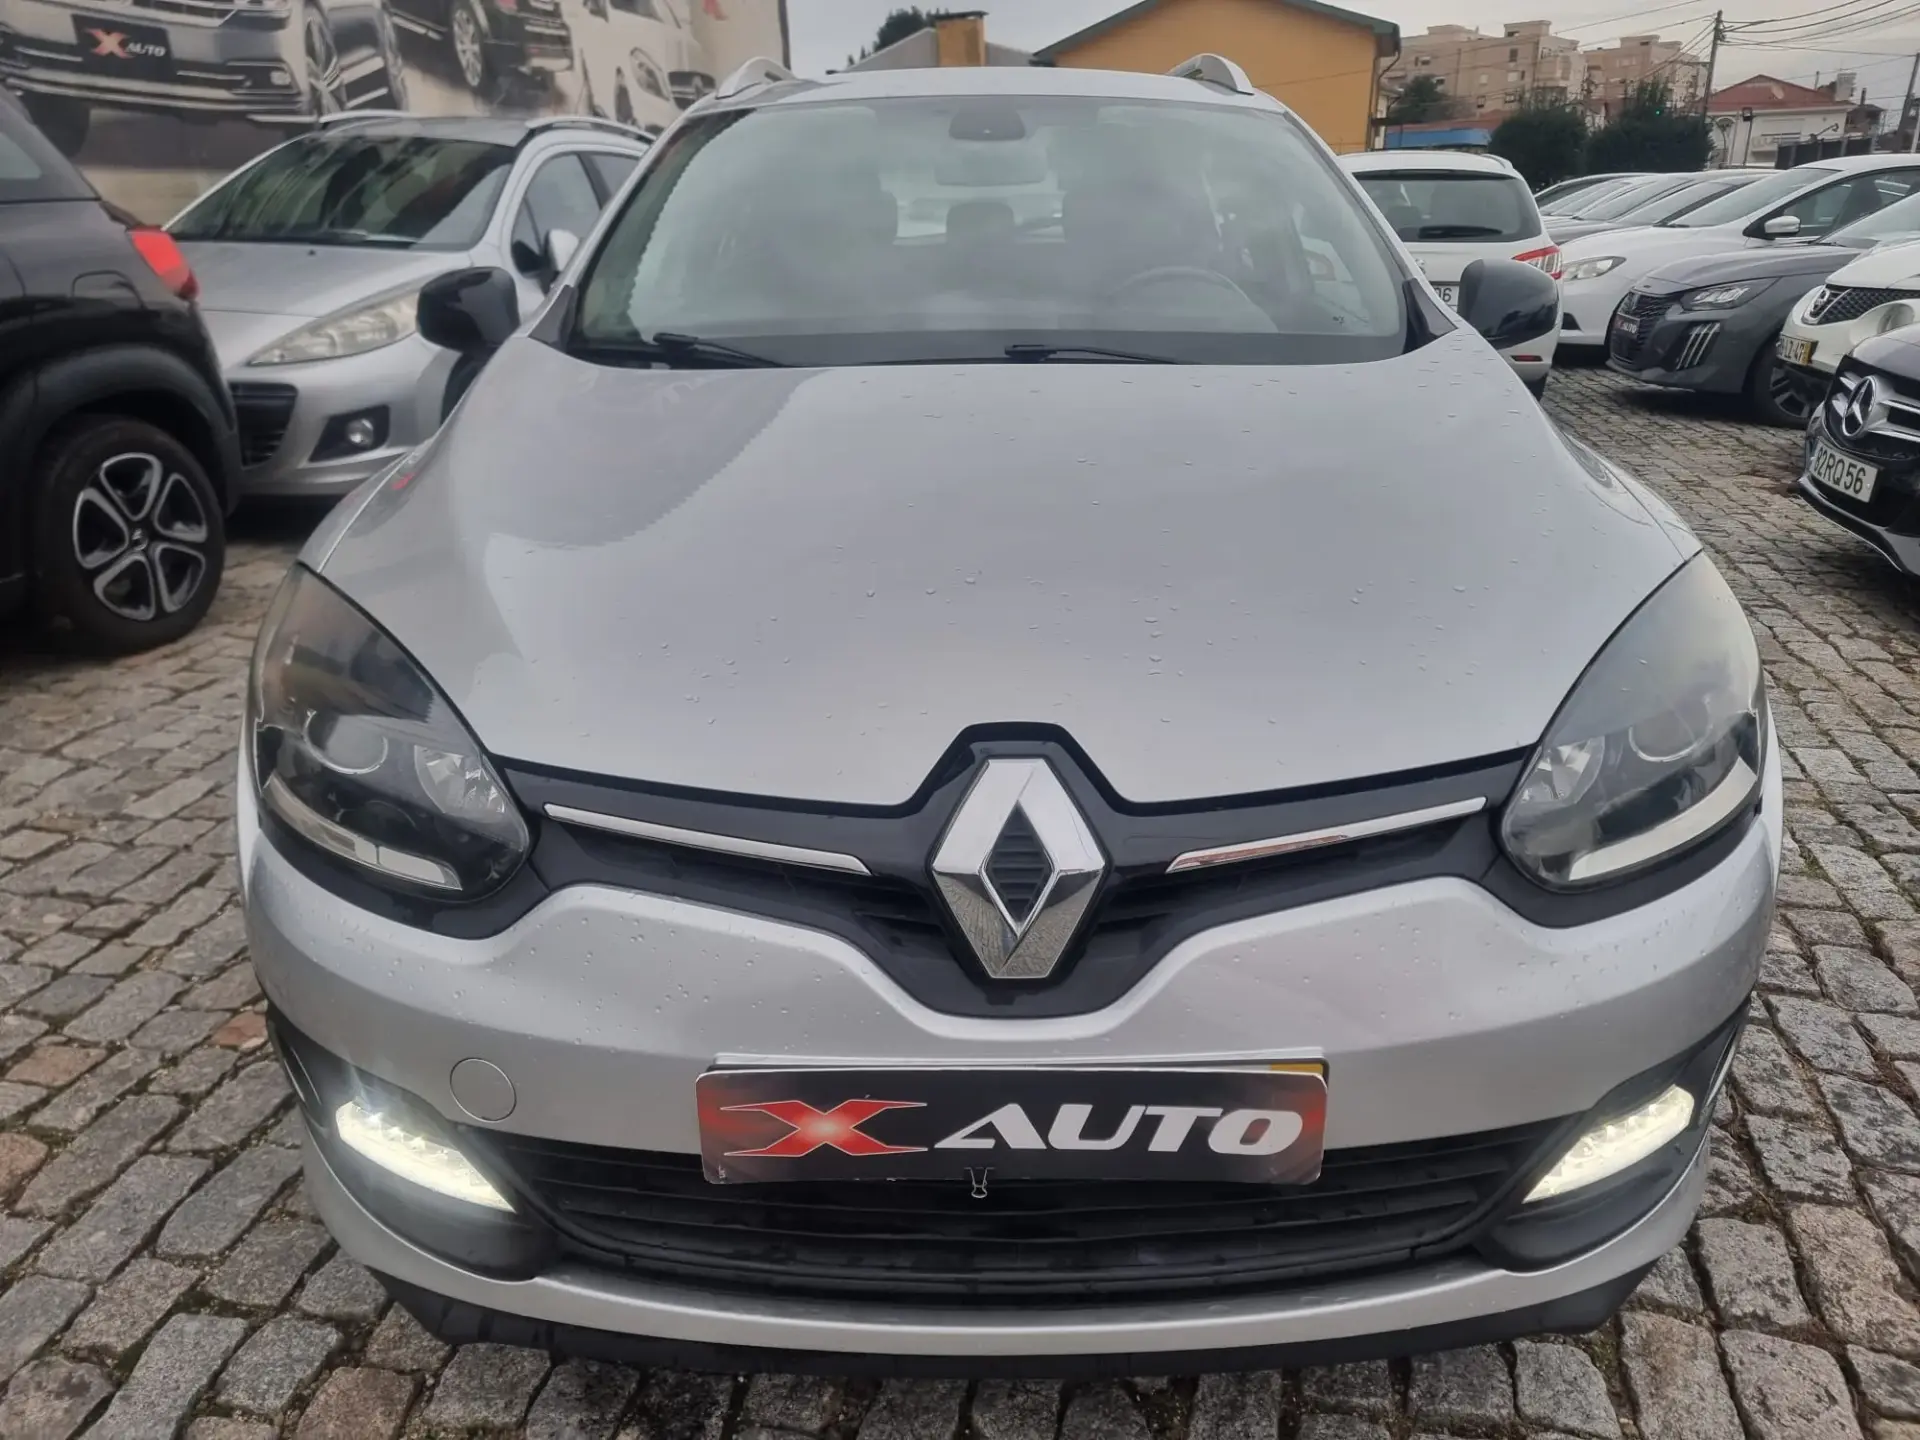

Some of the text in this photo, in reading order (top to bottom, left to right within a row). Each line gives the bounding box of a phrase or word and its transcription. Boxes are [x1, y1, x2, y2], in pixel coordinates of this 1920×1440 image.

[125, 42, 167, 57] AUTO
[720, 1099, 1304, 1157] X AUTO
